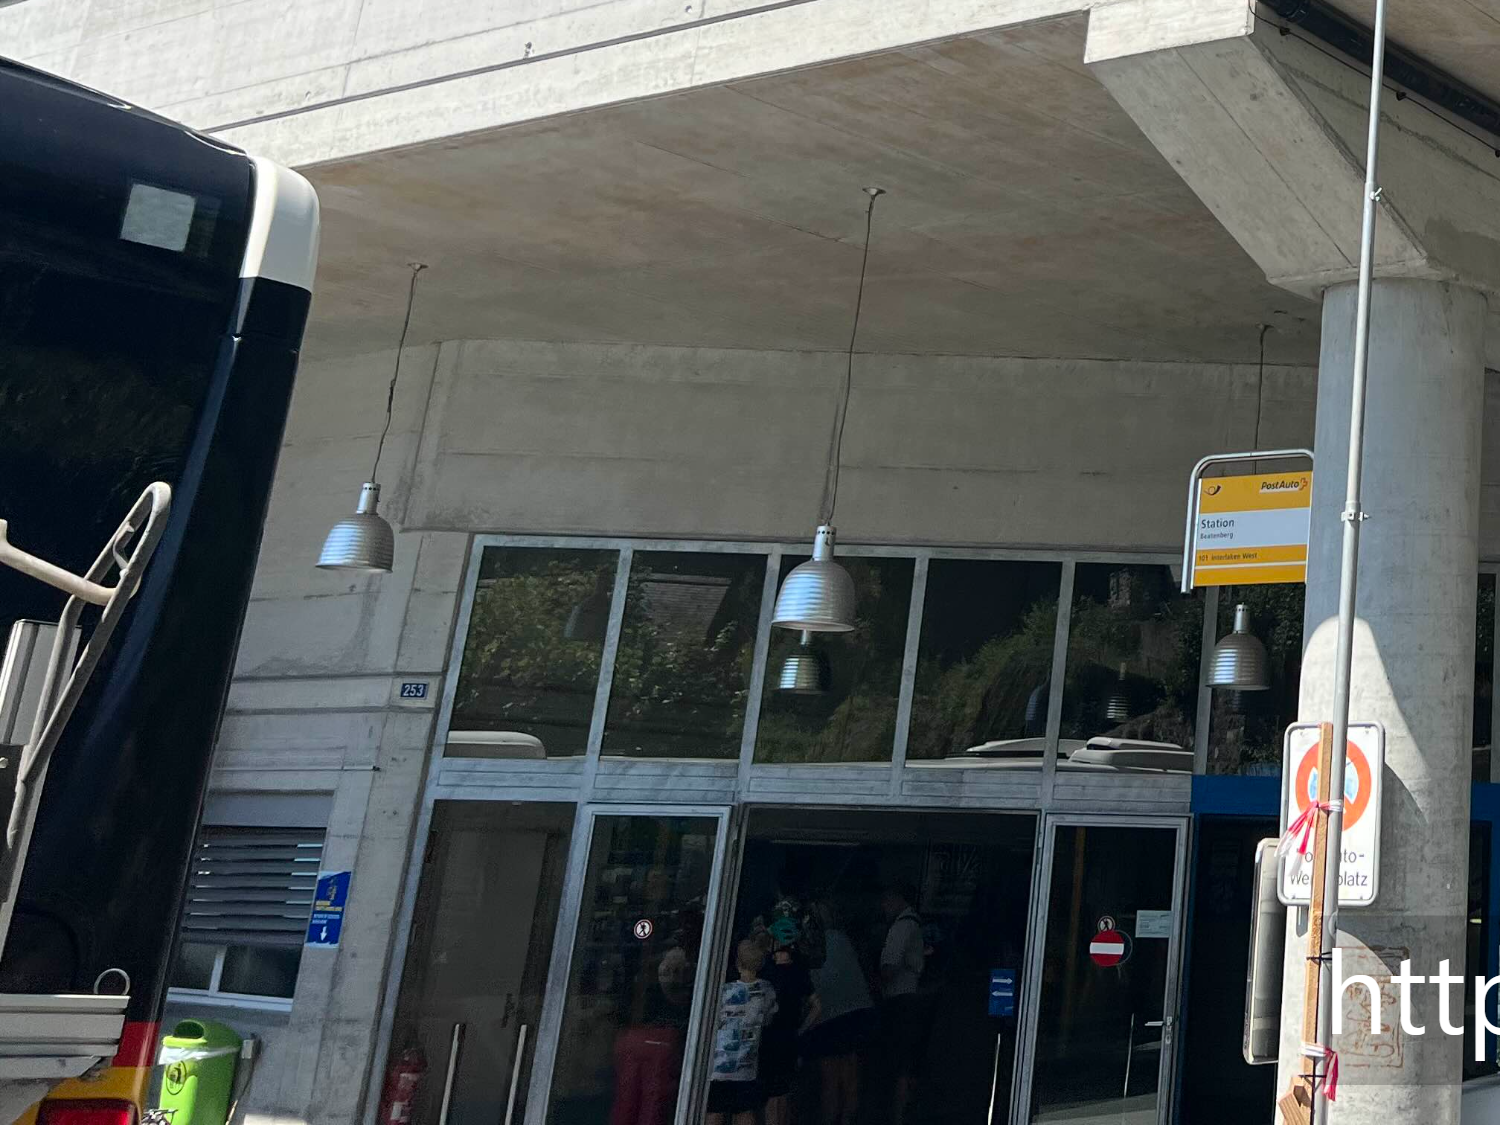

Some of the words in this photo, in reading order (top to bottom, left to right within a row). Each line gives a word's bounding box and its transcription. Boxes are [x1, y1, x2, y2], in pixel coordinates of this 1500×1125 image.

[1261, 480, 1299, 490] PostAuto
[1201, 519, 1235, 529] Station
[1200, 532, 1234, 540] Beatenberg
[403, 684, 424, 697] 253
